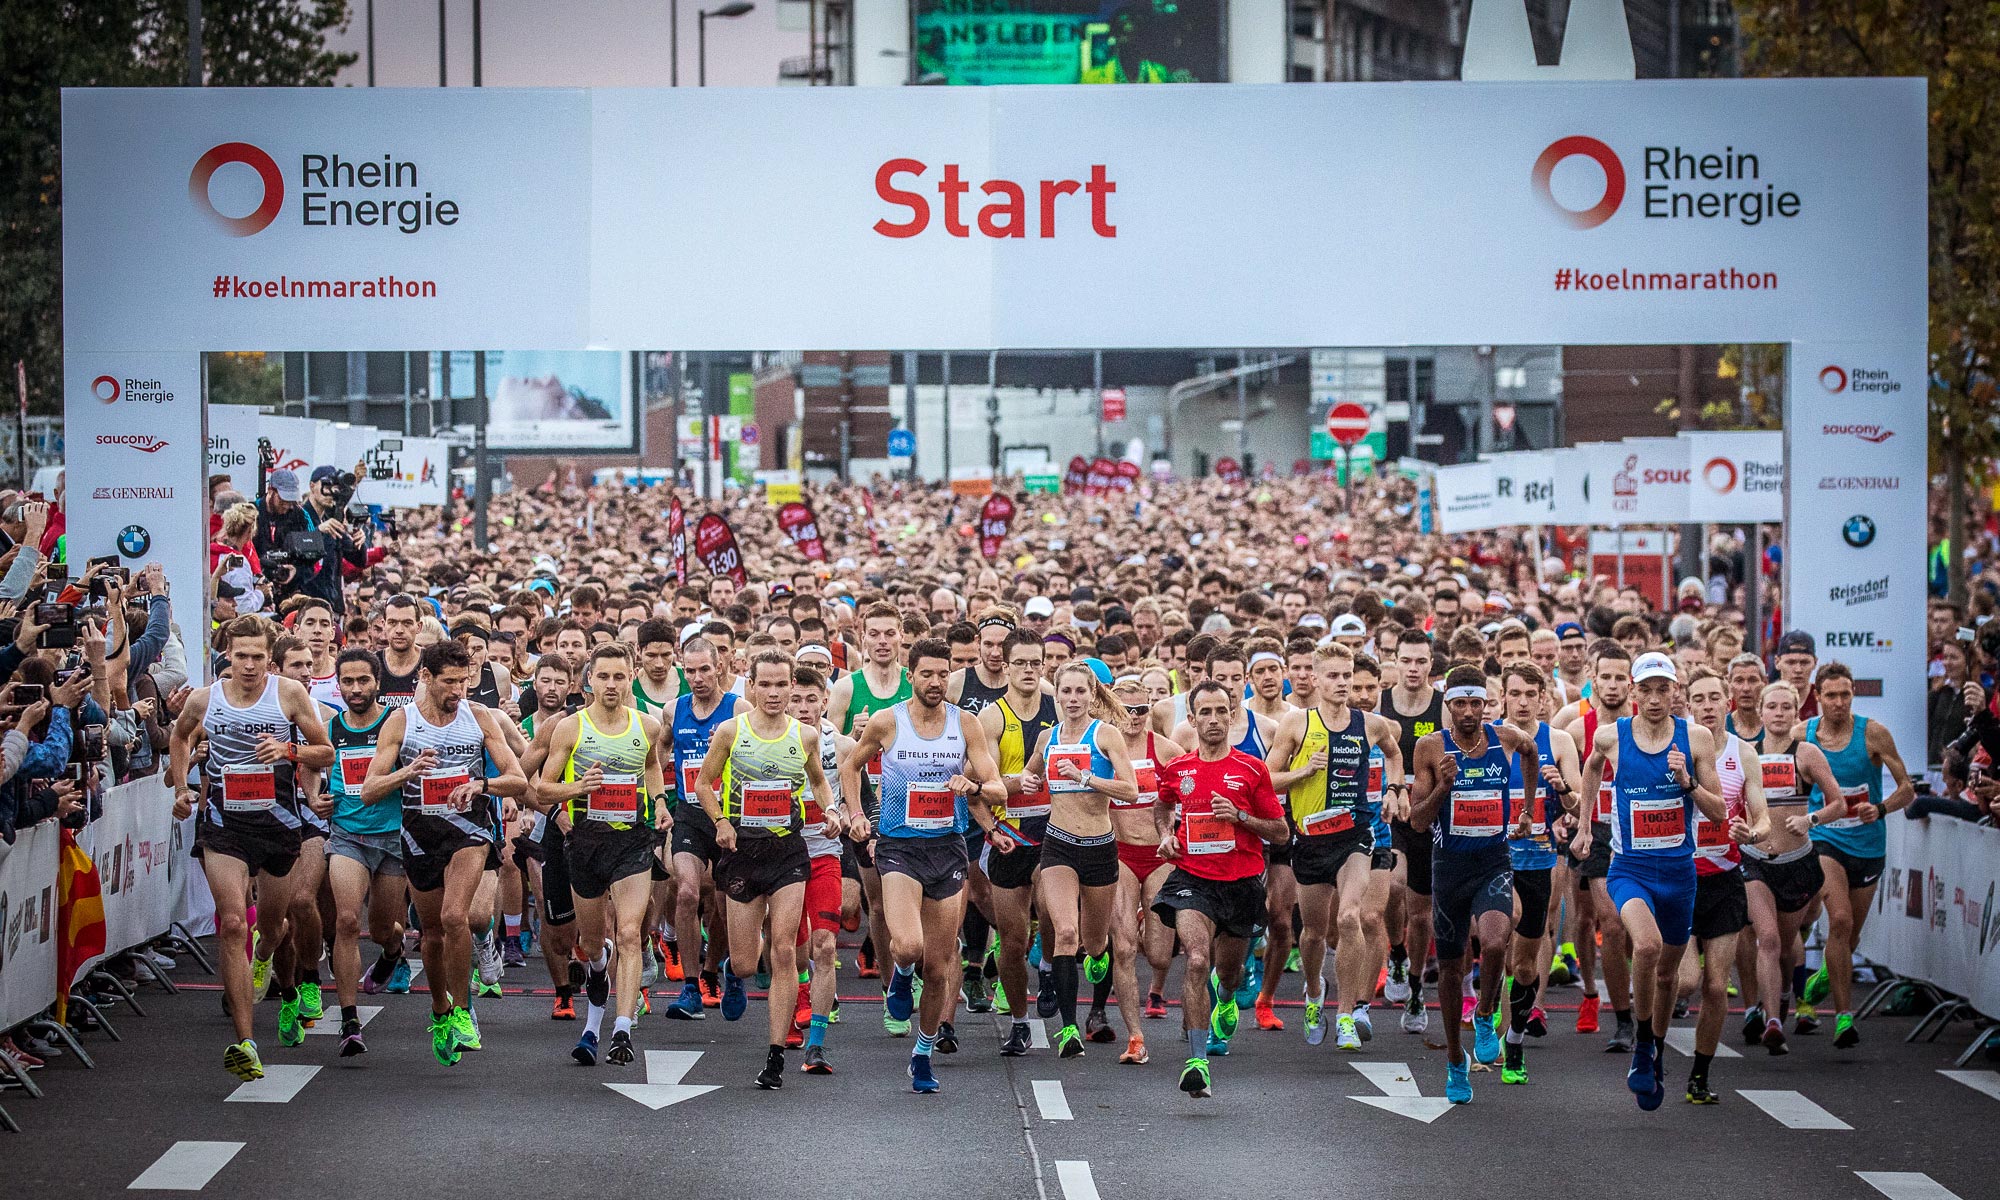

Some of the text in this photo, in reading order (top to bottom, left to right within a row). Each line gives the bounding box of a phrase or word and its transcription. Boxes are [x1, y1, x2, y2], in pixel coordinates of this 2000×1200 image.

[1644, 146, 1759, 180] Rhein
[302, 153, 417, 188] Rhein
[872, 158, 1117, 239] Start
[1643, 184, 1801, 226] Energie
[301, 192, 460, 235] Energie
[1554, 268, 1778, 291] #koelnmarathon
[212, 275, 437, 299] #koelnmarathon
[1852, 368, 1889, 380] Rhein
[125, 378, 162, 390] Rhein
[1852, 381, 1901, 394] Energie
[125, 390, 174, 404] Energie
[1823, 424, 1881, 436] saucony
[96, 434, 155, 448] saucony
[1838, 476, 1899, 490] GENERALI
[112, 486, 174, 499] GENERALI
[708, 547, 737, 576] 1:30
[1829, 574, 1890, 601] Reissdorf
[1826, 632, 1875, 647] REWE
[214, 723, 276, 735] LT DSHS
[447, 744, 475, 756] DSHS
[908, 751, 961, 760] TELIS FINANZ
[597, 787, 632, 796] Marius
[746, 792, 788, 802] Frederik
[917, 794, 948, 804] Kevin
[1458, 802, 1499, 812] Amanal
